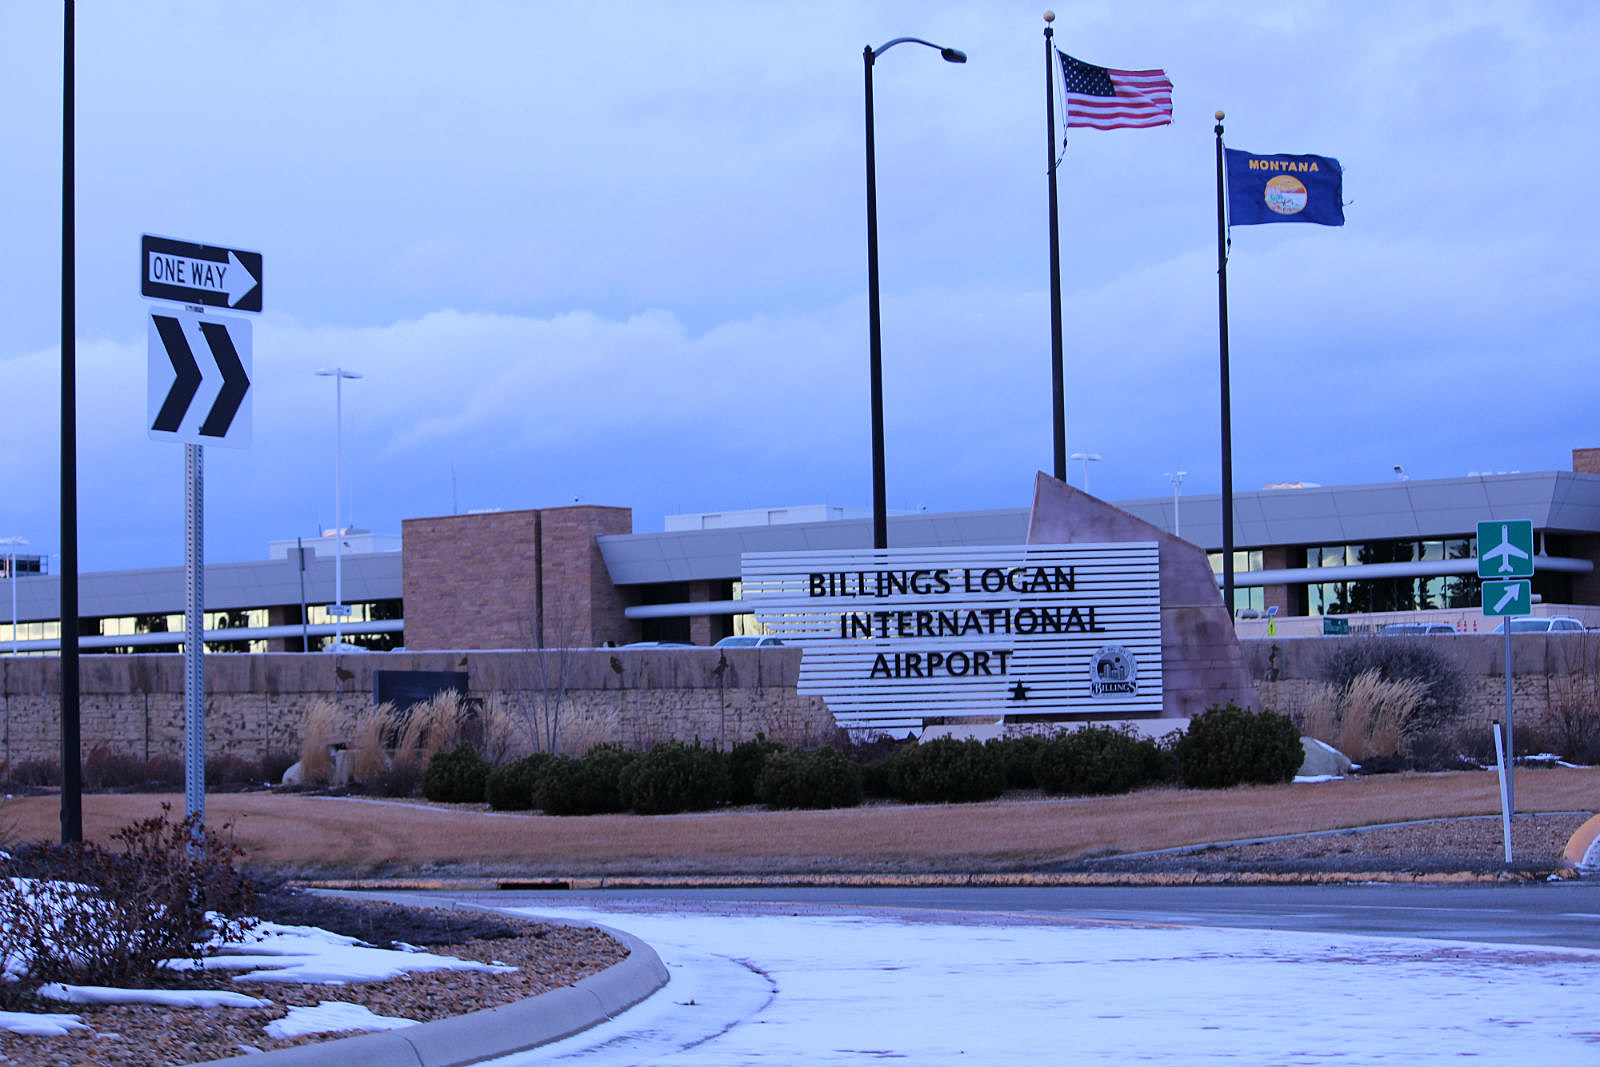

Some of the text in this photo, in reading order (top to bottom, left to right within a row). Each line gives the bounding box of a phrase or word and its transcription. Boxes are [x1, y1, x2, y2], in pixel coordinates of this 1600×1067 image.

[1249, 160, 1319, 172] MONTANA
[154, 256, 227, 289] ONE WAY
[809, 566, 1076, 597] BILLINGS LOGAN
[841, 606, 1106, 639] INTERNATIONAL
[870, 650, 1012, 679] AIRPORT
[1093, 682, 1136, 694] BILLINGS
